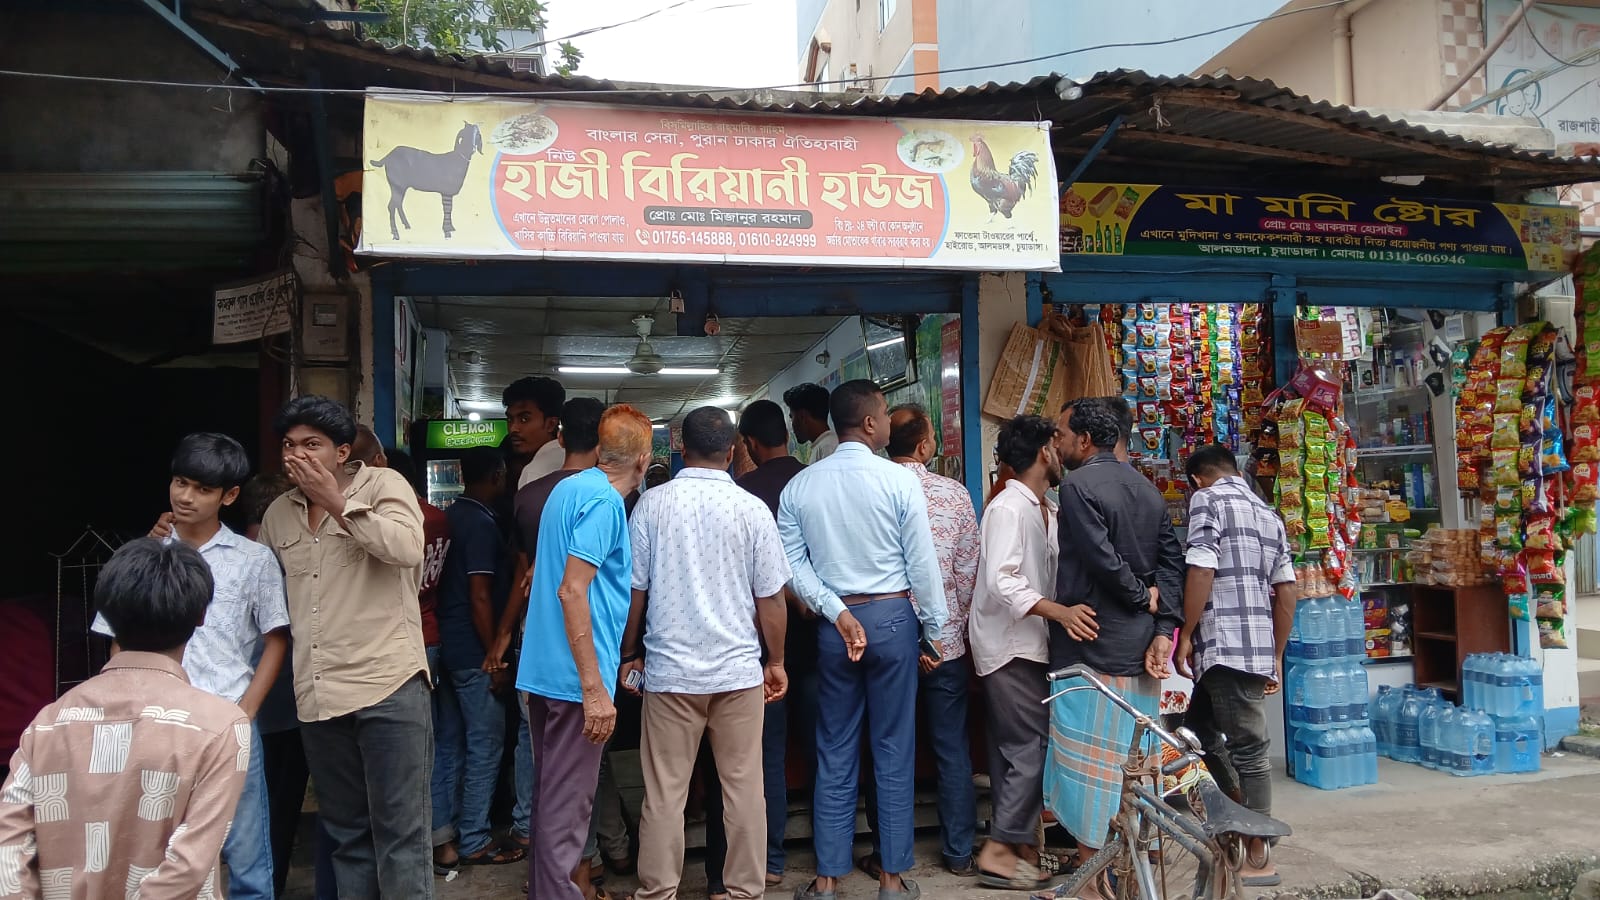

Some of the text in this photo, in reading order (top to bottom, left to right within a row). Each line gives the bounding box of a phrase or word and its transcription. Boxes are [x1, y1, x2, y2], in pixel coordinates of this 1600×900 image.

[586, 128, 860, 152] বাংলার সেরা, পুরান ঢাকার ঐতিহ্যবাহী
[546, 148, 577, 162] নিউ
[500, 148, 934, 211] হাজী বিরিয়ানী হাউজ
[513, 212, 536, 225] এখানে
[649, 209, 802, 226] প্রোঃ মোঃ মিজানুর রহমান
[1175, 192, 1481, 229] মা মনি ষ্টোর
[1264, 219, 1403, 236] প্রোঃ মোঃ আকরাম হোসাইন
[652, 230, 817, 248] 01756-145888, 01610-824999
[1140, 229, 1174, 241] এখানে
[1178, 229, 1218, 242] মুদিখানা
[1223, 232, 1231, 241] ও
[1235, 230, 1302, 244] কনফেকশনারী
[1305, 235, 1323, 244] সহ
[1326, 234, 1361, 247] যাবতীয়
[1364, 235, 1386, 248] নিত্য
[1389, 237, 1436, 251] প্রয়োজনীয়
[1438, 241, 1457, 252] পণ্য
[1460, 242, 1488, 254] পাওয়া
[1330, 247, 1366, 260] মোবাঃ
[1368, 250, 1466, 265] 01310-606946
[443, 422, 494, 435] CLEMON
